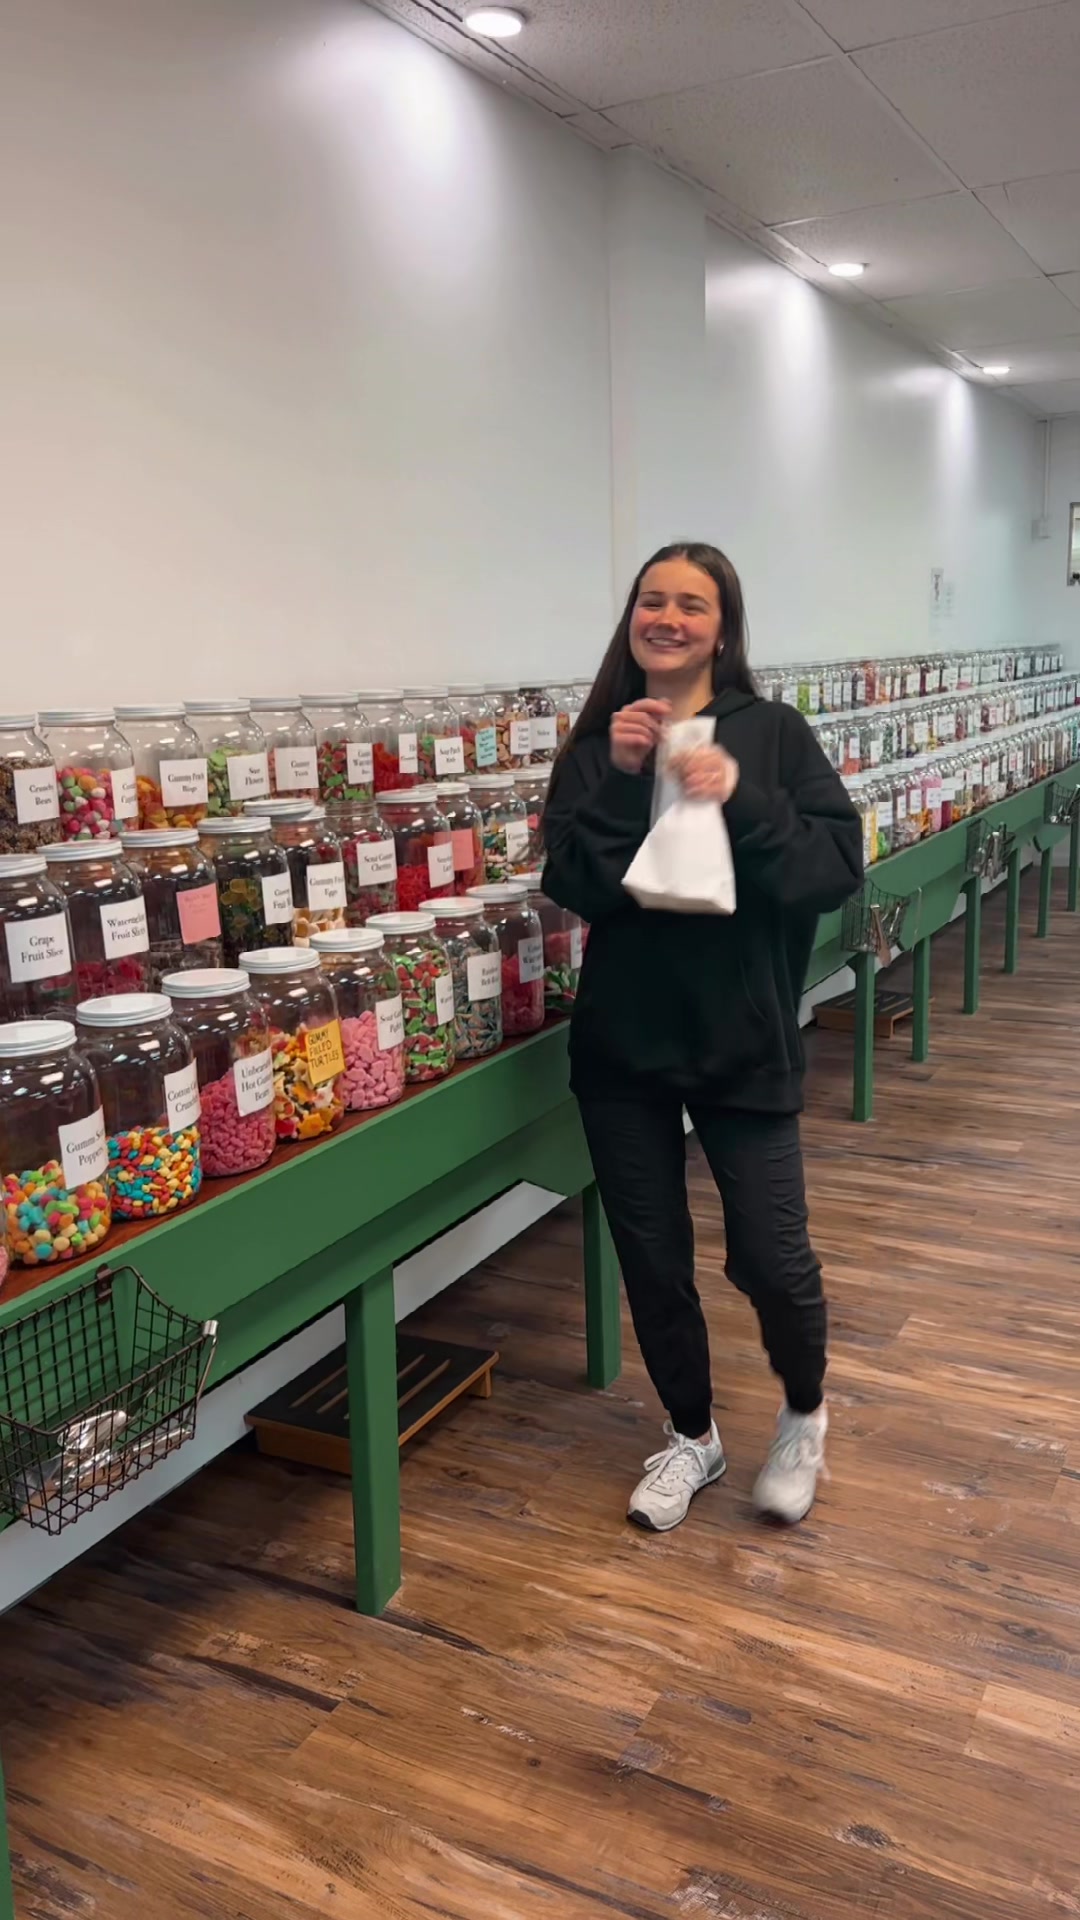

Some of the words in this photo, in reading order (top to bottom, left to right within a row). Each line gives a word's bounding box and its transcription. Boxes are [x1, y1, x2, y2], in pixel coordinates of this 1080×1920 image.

[29, 935, 55, 948] Grape
[111, 929, 131, 941] Fruit
[21, 950, 45, 963] Fruit
[308, 1028, 329, 1046] GUMMY
[309, 1039, 332, 1058] FILLED
[310, 1050, 339, 1071] TURTLES
[167, 1086, 191, 1102] Cotton
[241, 1080, 257, 1094] Hot
[78, 1147, 104, 1167] Poppers
